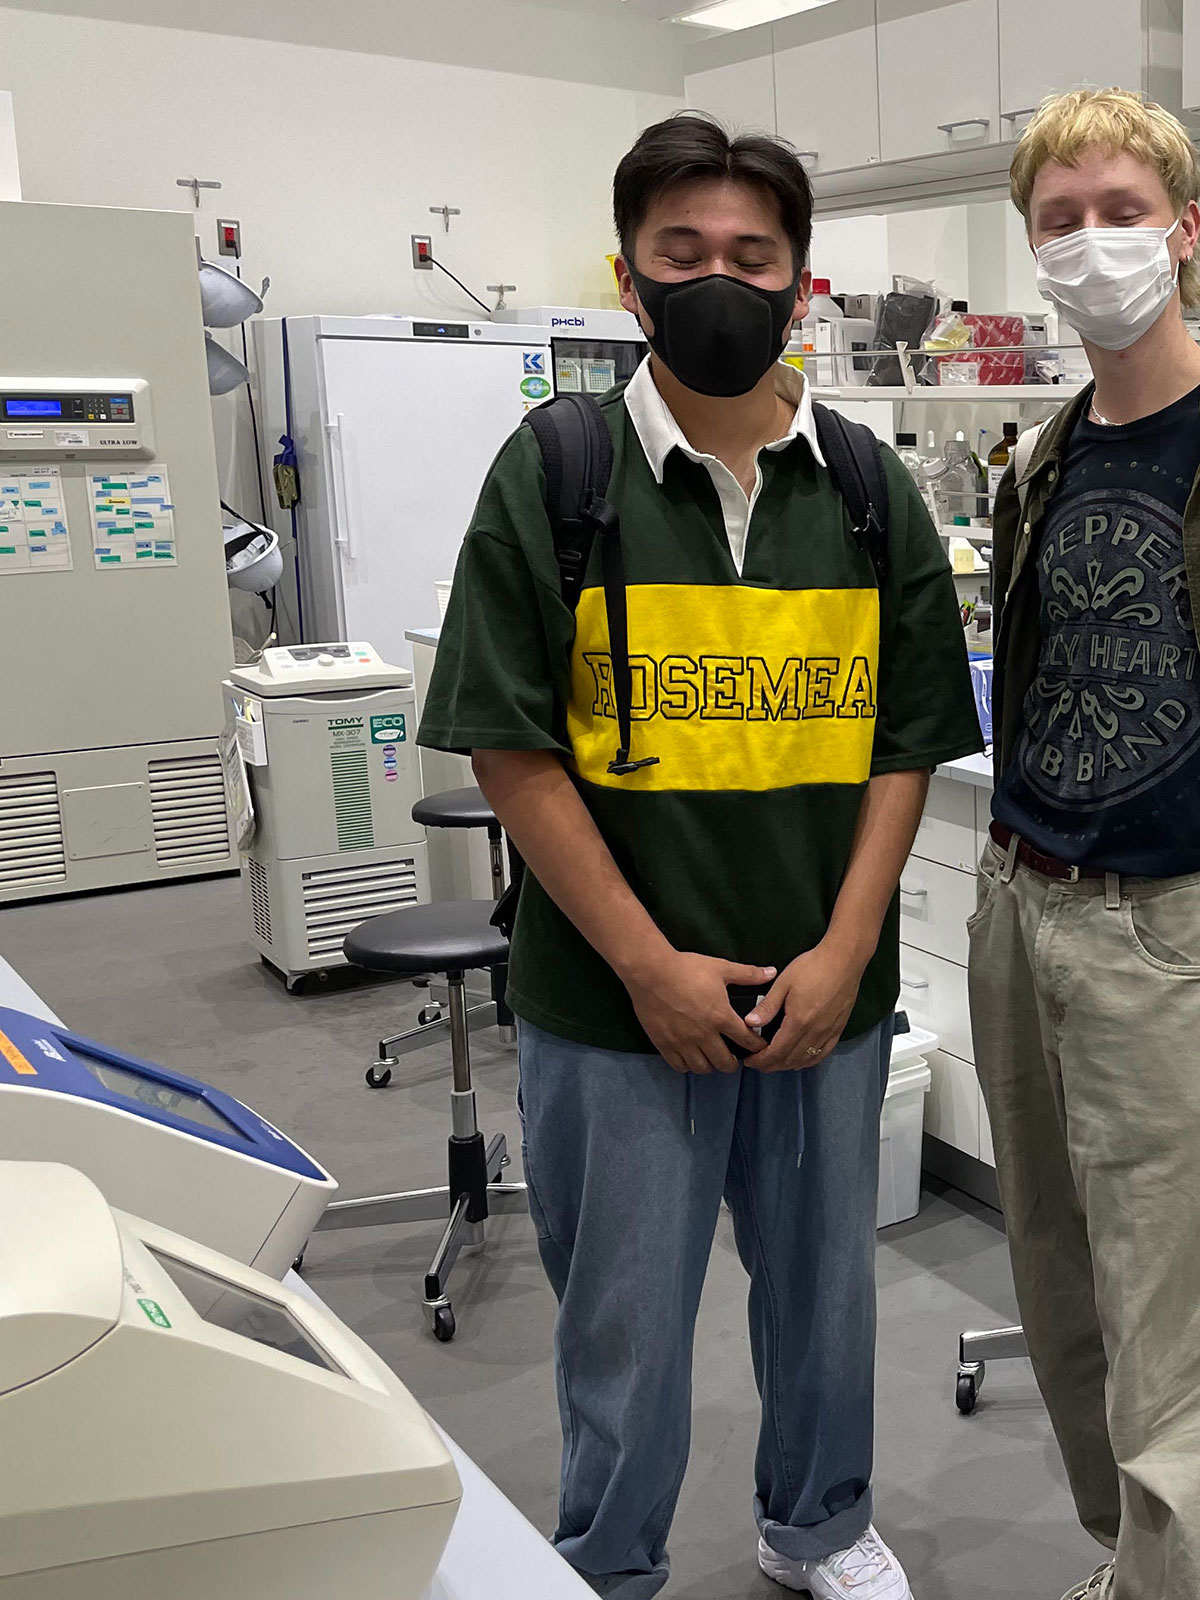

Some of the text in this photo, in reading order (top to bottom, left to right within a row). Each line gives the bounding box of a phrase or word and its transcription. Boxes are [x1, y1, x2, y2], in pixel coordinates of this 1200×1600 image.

[327, 717, 363, 726] TOMY
[373, 717, 403, 728] ECO
[332, 729, 361, 737] MX-307
[1077, 699, 1186, 782] BAND
